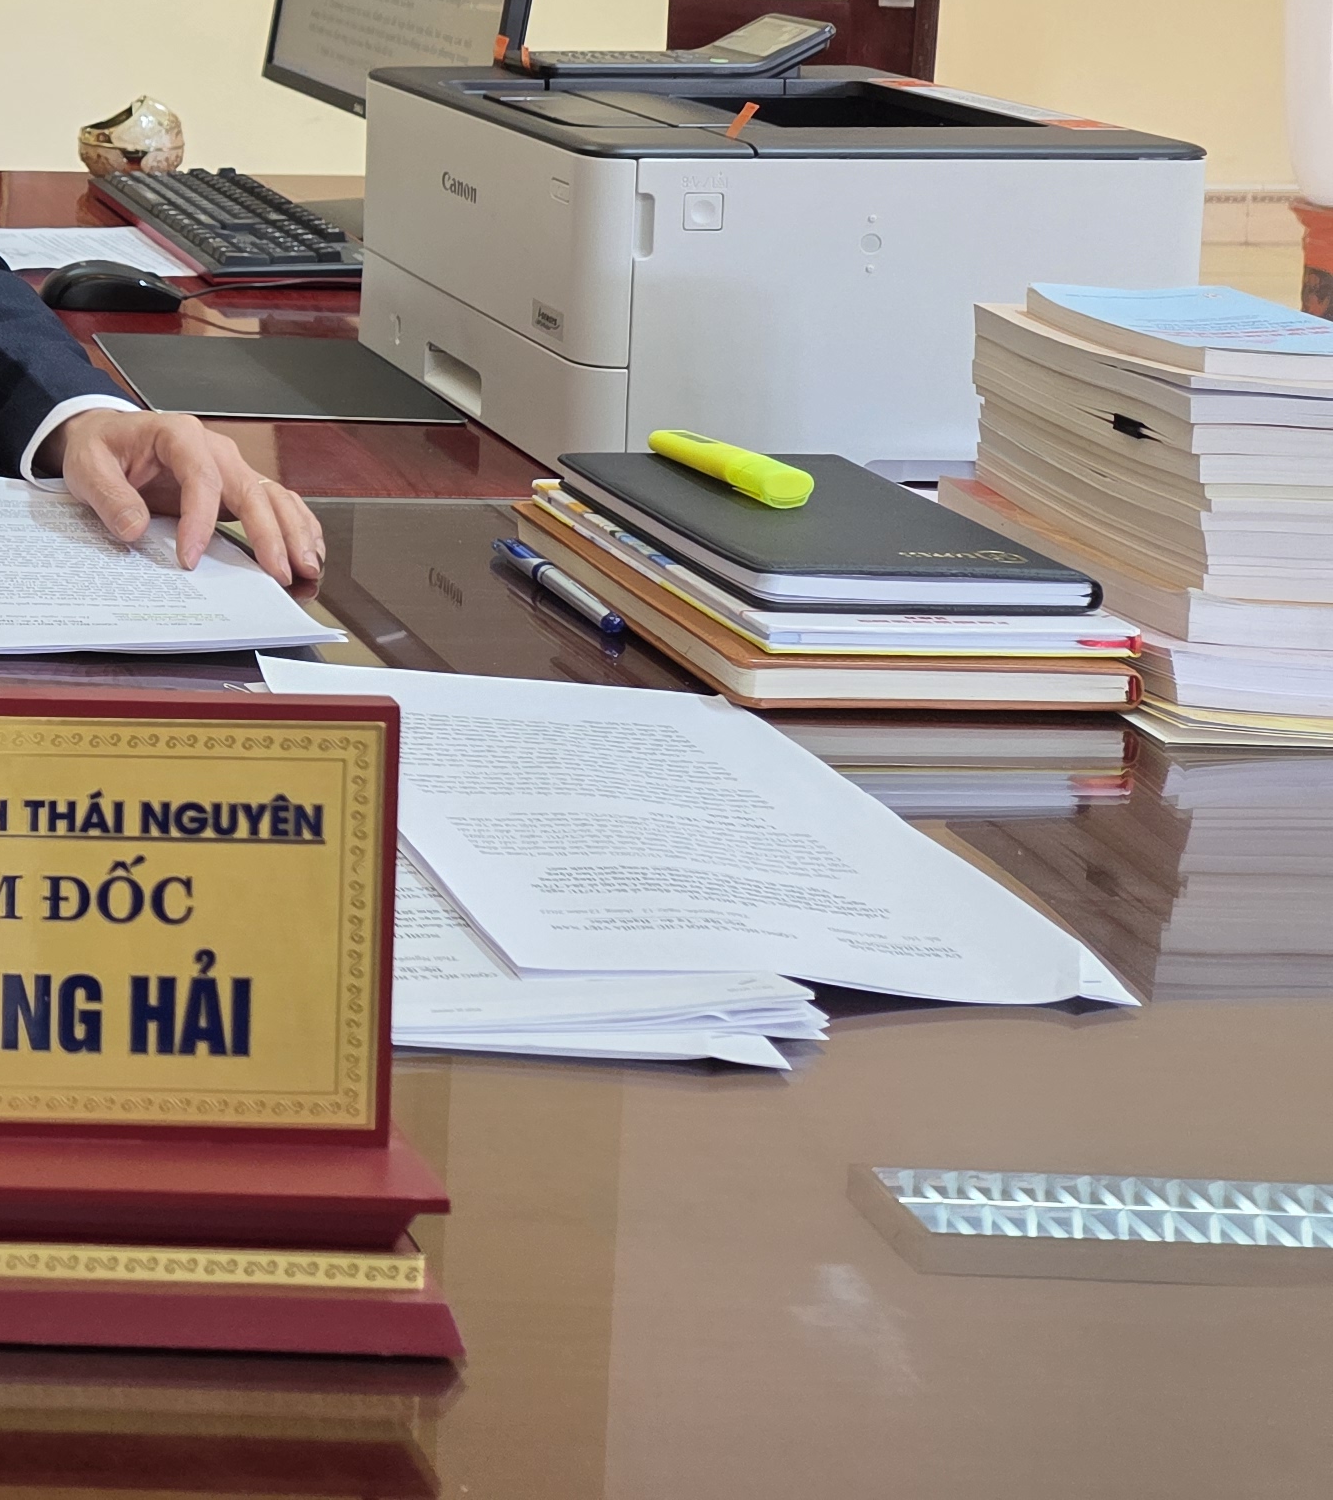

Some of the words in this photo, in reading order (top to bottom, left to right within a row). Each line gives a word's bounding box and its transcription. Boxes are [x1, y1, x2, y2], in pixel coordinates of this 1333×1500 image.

[441, 170, 477, 204] Canon
[24, 788, 125, 835] THÁI
[141, 793, 324, 839] NGUYÊN
[41, 854, 194, 925] ĐỐC
[128, 948, 253, 1059] HẢI
